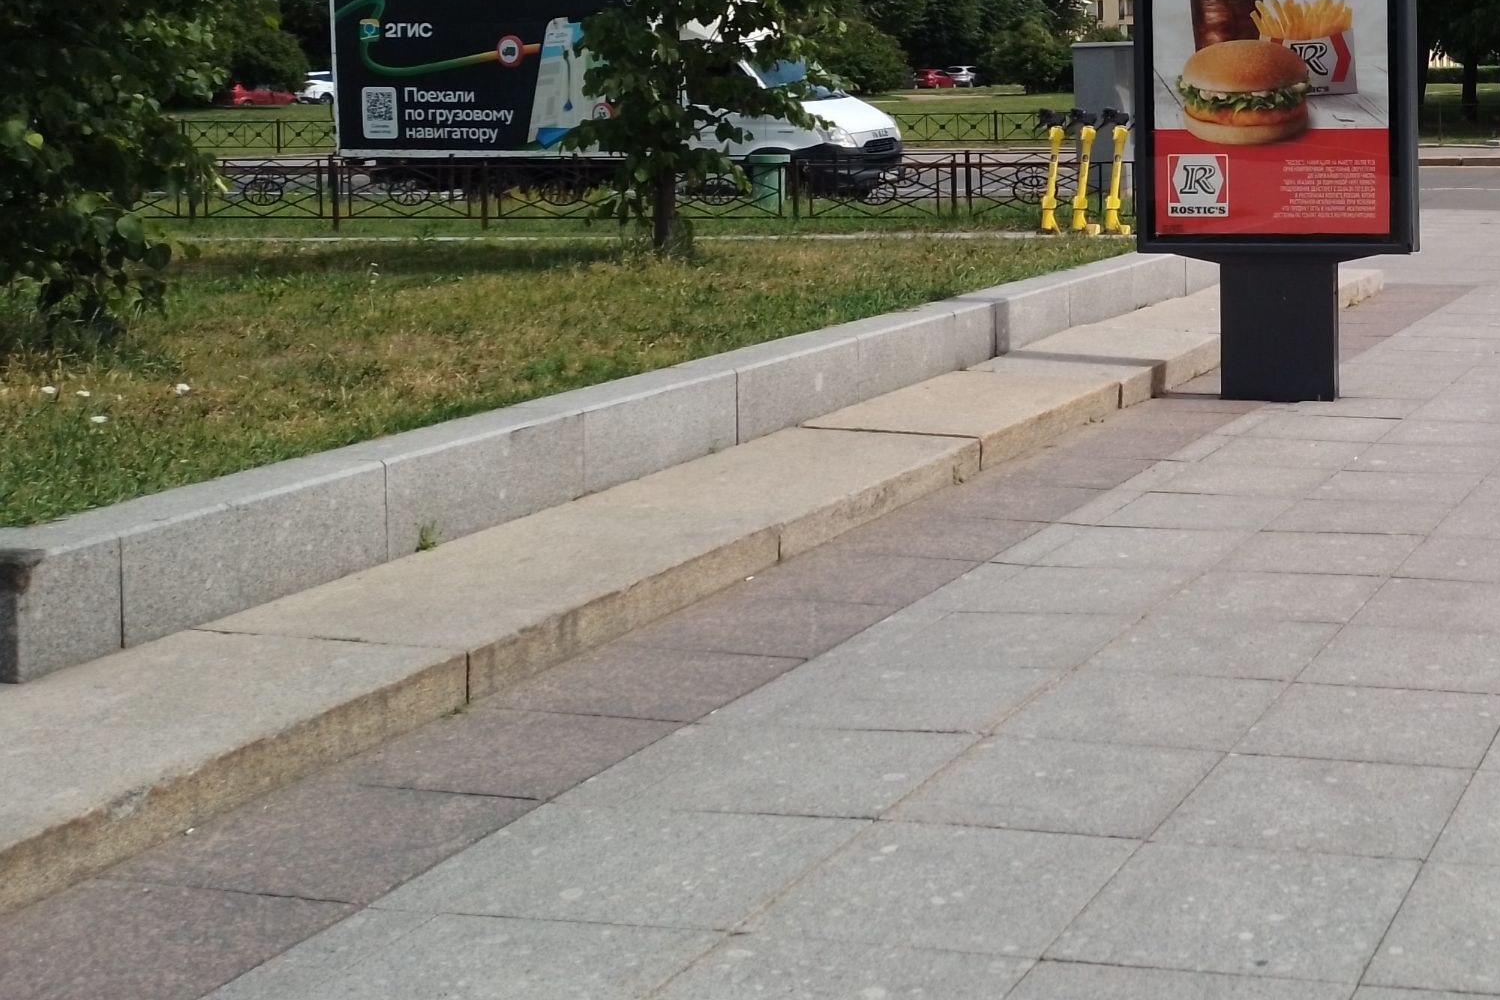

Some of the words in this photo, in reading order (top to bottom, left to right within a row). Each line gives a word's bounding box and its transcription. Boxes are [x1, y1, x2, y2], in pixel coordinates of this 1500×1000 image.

[384, 22, 434, 39] 2ГИС
[404, 86, 475, 104] Поехали
[405, 108, 425, 121] по
[428, 108, 515, 125] грузовому
[405, 126, 499, 144] навигатору
[1179, 164, 1216, 195] R
[1170, 206, 1226, 214] ROSTIC'S
